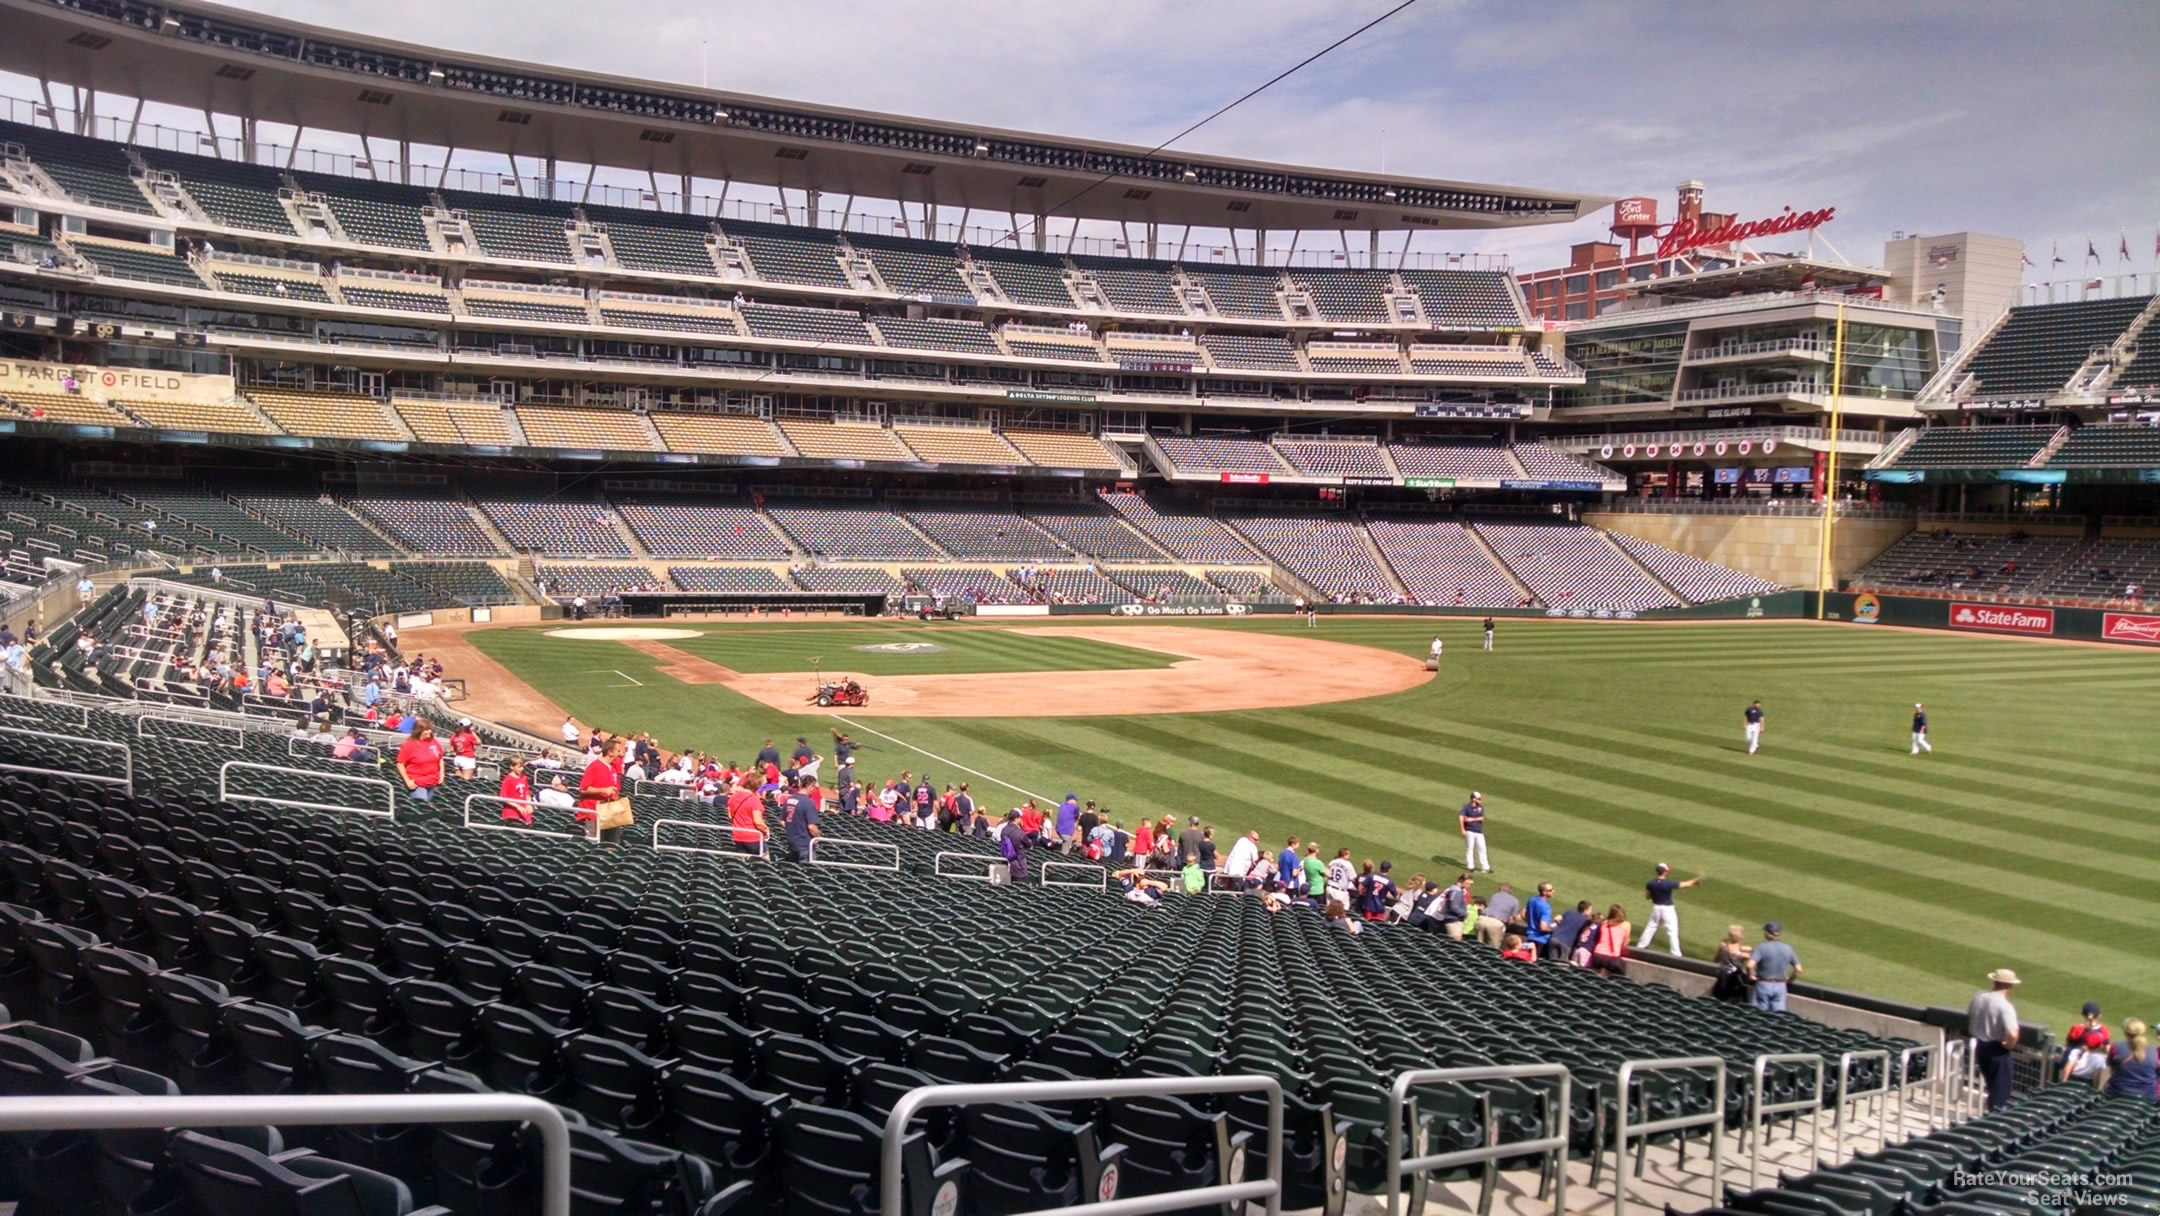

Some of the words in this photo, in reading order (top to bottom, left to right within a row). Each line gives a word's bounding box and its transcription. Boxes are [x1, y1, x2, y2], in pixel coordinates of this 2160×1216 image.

[1619, 200, 1641, 214] Ford
[1622, 212, 1651, 222] Center
[1653, 205, 1836, 258] Budweiser
[1654, 336, 1684, 348] BASEBALL
[15, 364, 98, 384] TARGET
[121, 374, 181, 391] FIELD
[1708, 409, 1723, 418] GOOSE
[1723, 408, 1740, 417] ISLAND
[1741, 407, 1751, 416] PUB
[1147, 606, 1160, 614] Go
[1162, 606, 1185, 614] Music
[1187, 606, 1199, 614] Go
[1200, 606, 1223, 614] Twins
[1331, 868, 1342, 881] 16
[1372, 882, 1383, 896] 7
